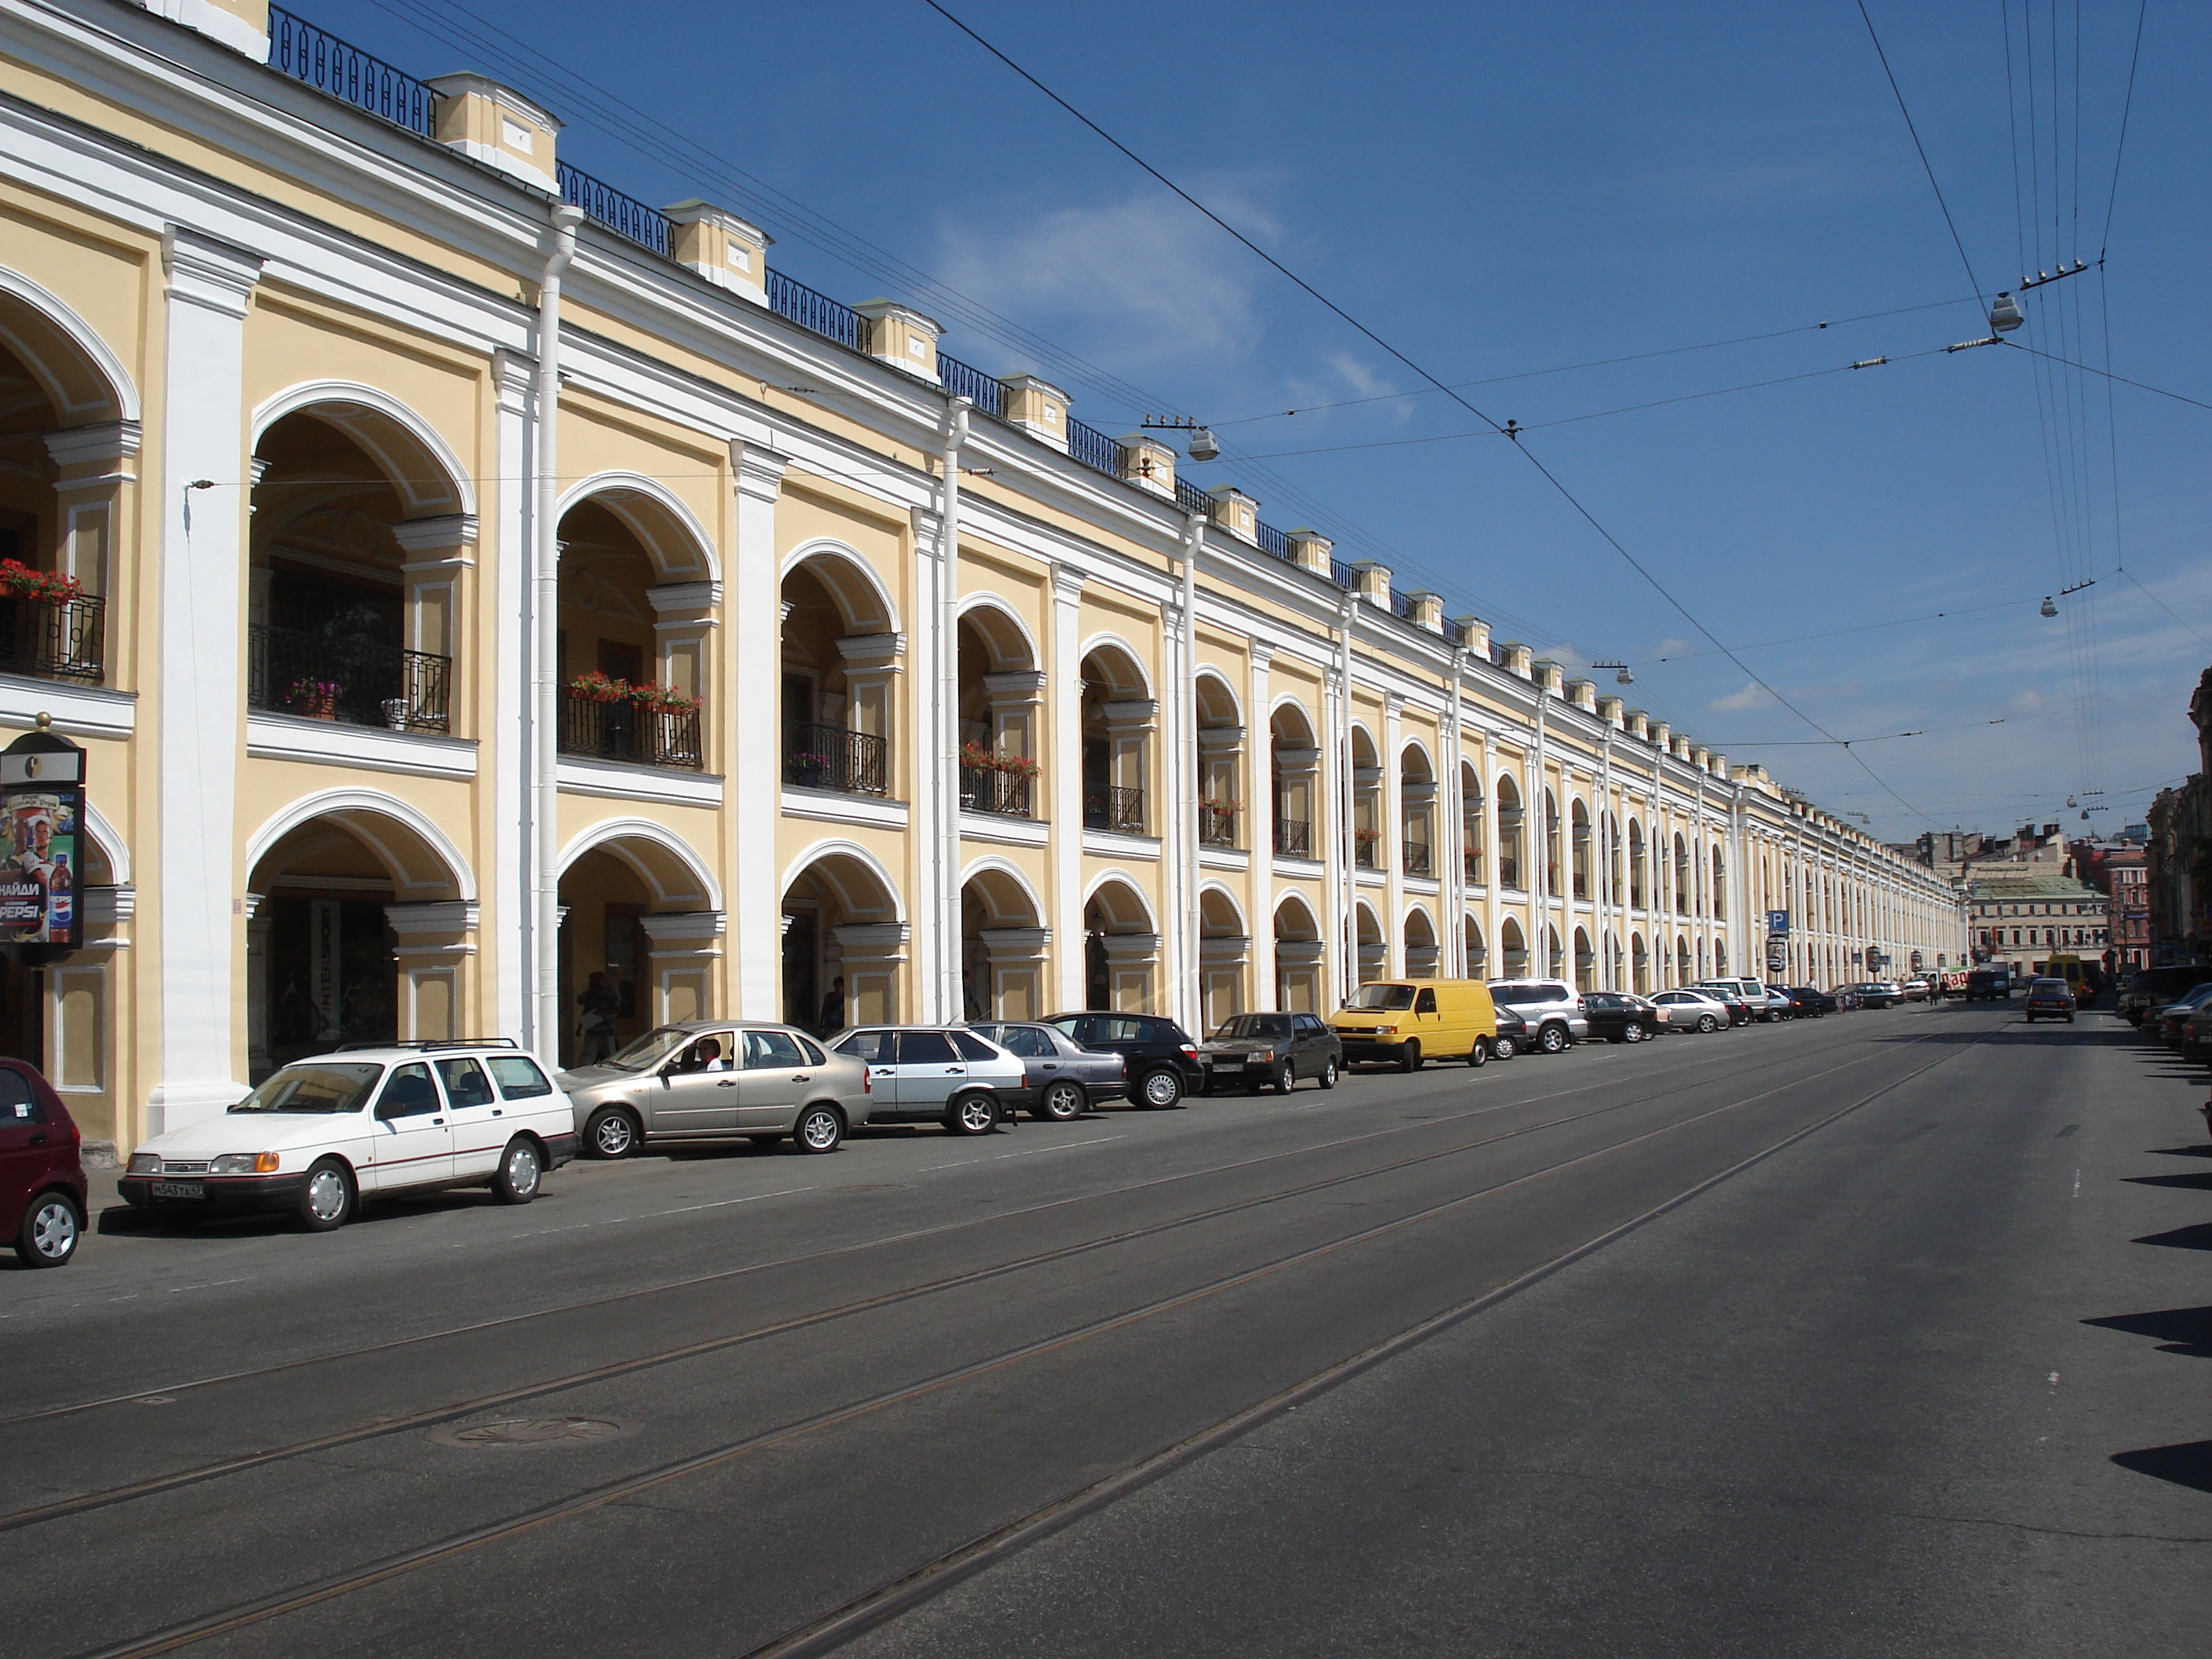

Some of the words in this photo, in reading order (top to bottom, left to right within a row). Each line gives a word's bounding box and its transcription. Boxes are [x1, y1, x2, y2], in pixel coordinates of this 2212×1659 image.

[0, 881, 39, 895] НАЙДИ
[0, 905, 38, 918] PEPSI
[1773, 913, 1784, 928] P
[321, 906, 331, 1011] INTERSPORT
